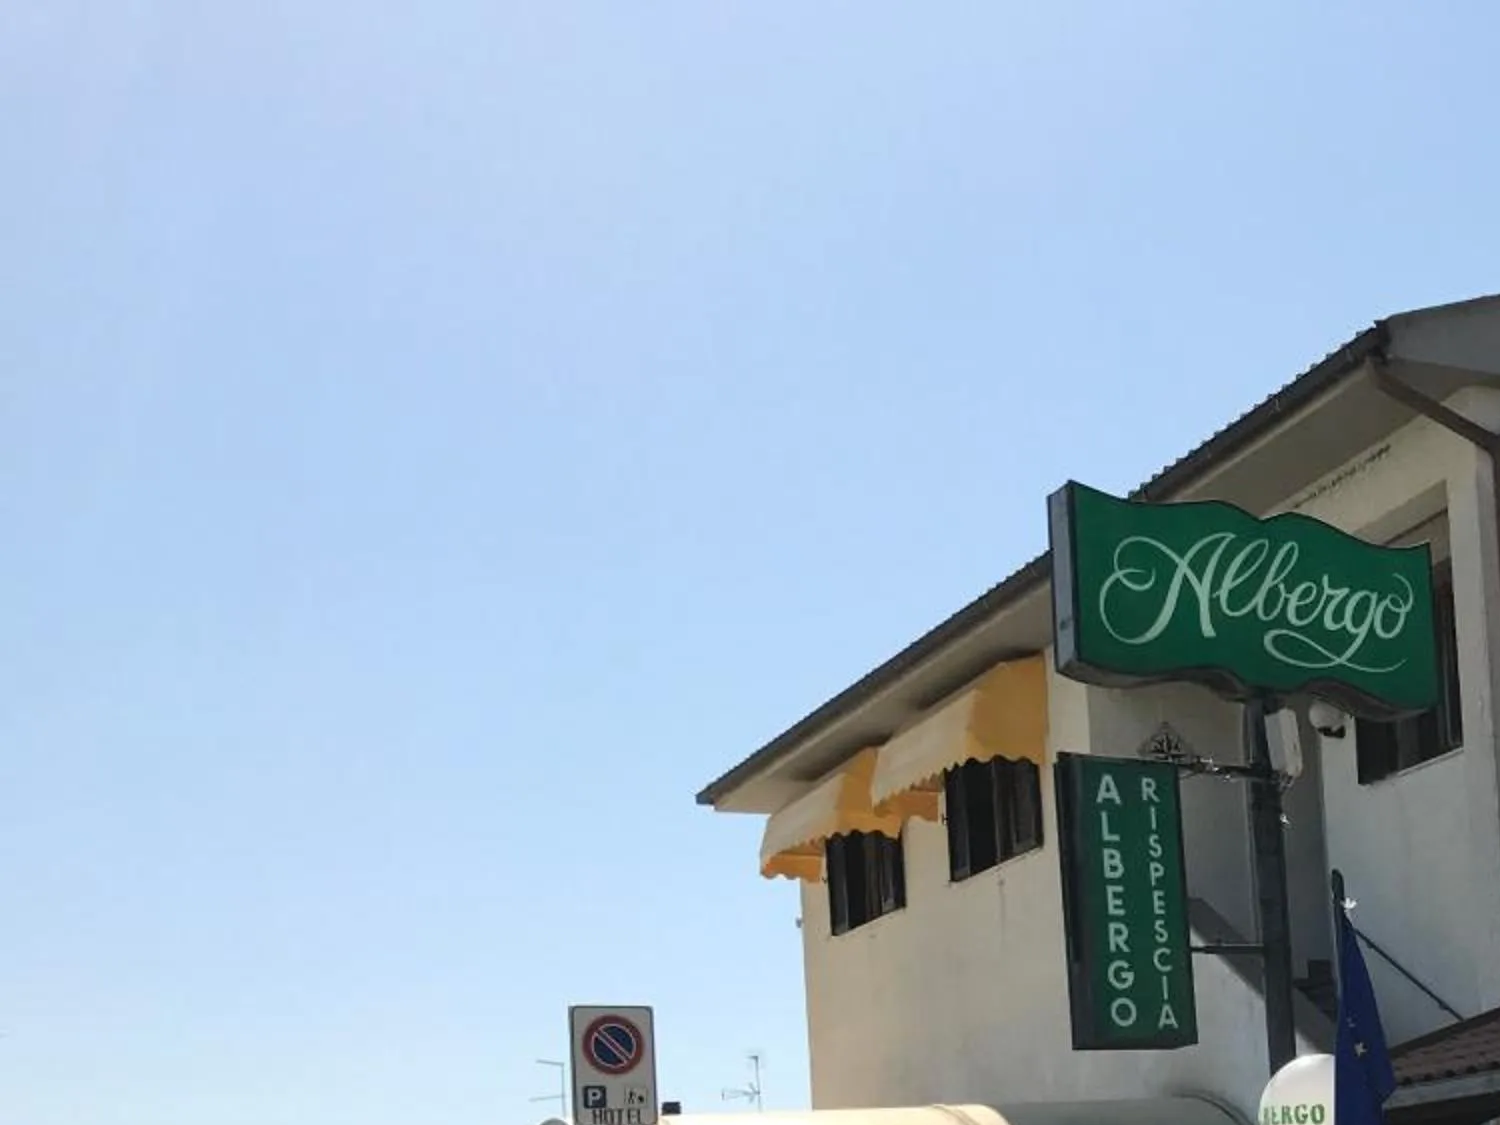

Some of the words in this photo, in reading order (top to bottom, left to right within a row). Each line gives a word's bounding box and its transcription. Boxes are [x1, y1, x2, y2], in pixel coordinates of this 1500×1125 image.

[1100, 531, 1414, 673] Albergo
[1096, 773, 1138, 1027] ALBERGO
[1140, 777, 1180, 1030] RISPESCIA
[592, 1107, 646, 1125] HOTEL
